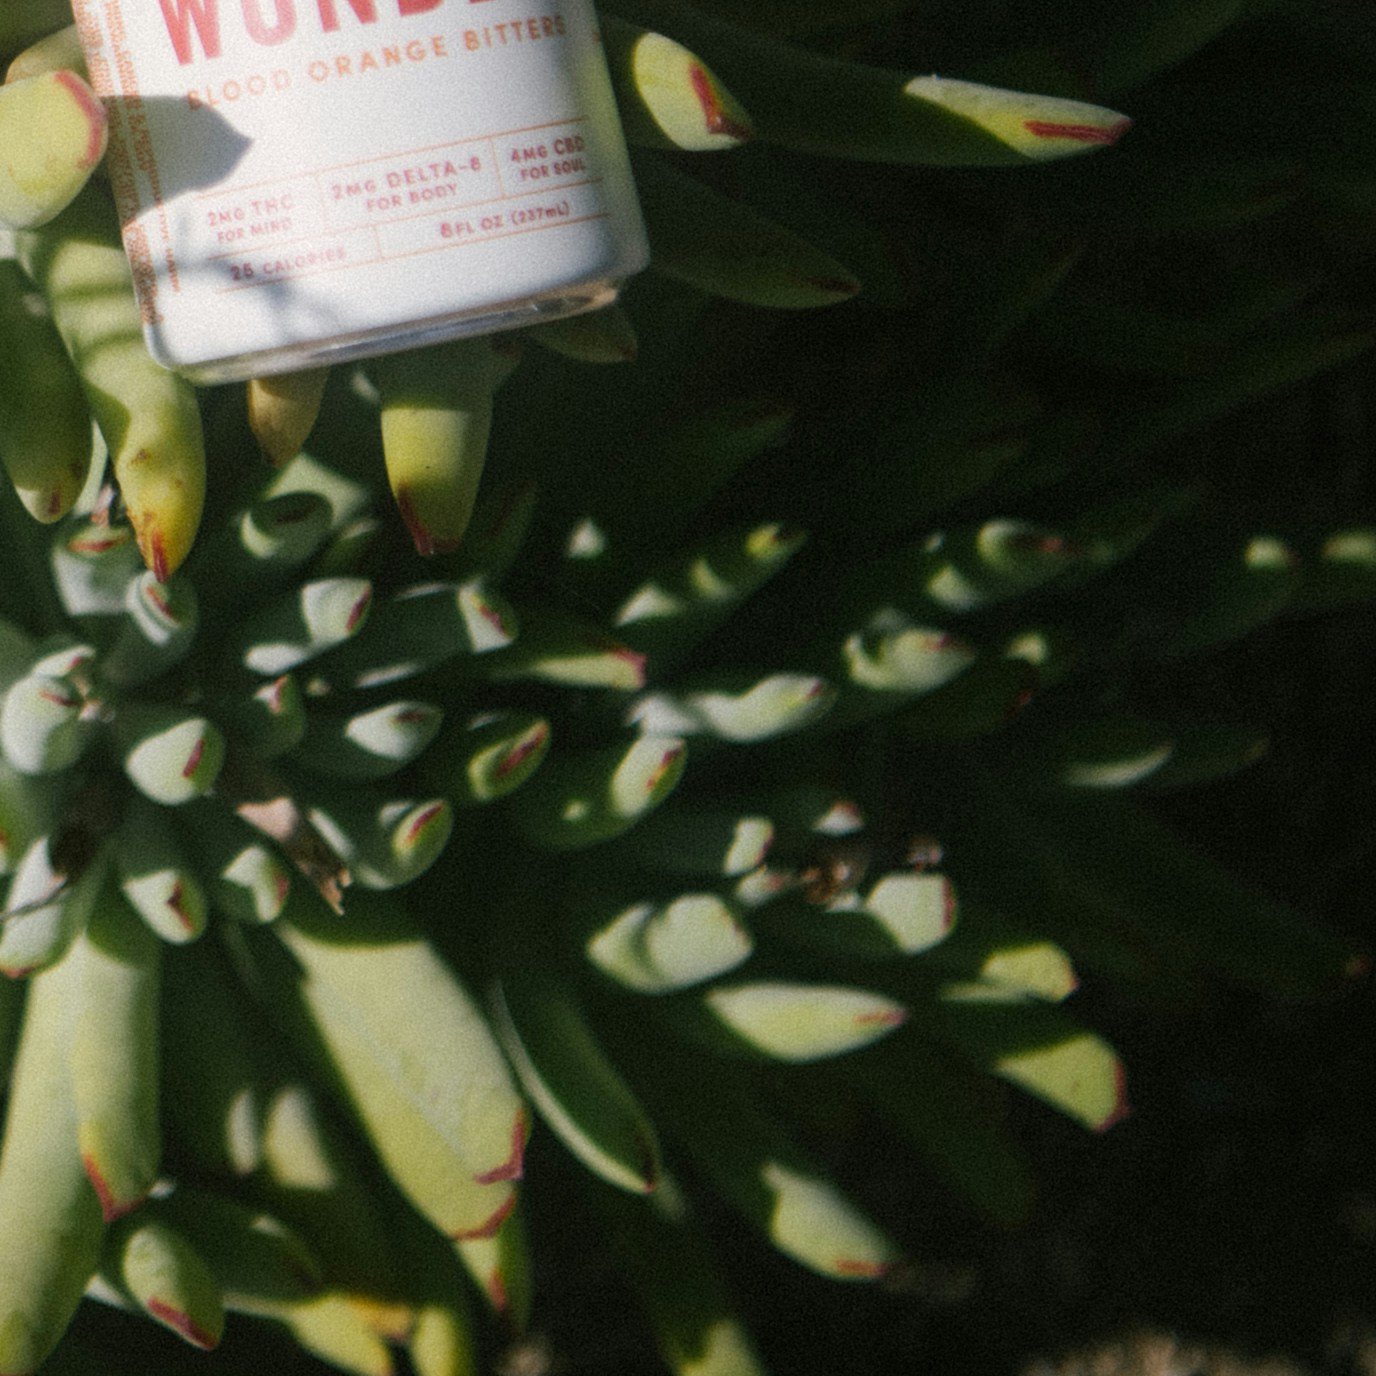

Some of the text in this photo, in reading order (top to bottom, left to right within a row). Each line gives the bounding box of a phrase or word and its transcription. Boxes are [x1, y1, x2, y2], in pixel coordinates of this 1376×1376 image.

[186, 14, 566, 112] BLOOD ORANGE BITTERS
[511, 145, 548, 164] 4MG
[332, 156, 482, 200] 2MG DELTA-8
[520, 165, 550, 182] FOR
[367, 183, 458, 212] FOR BODY
